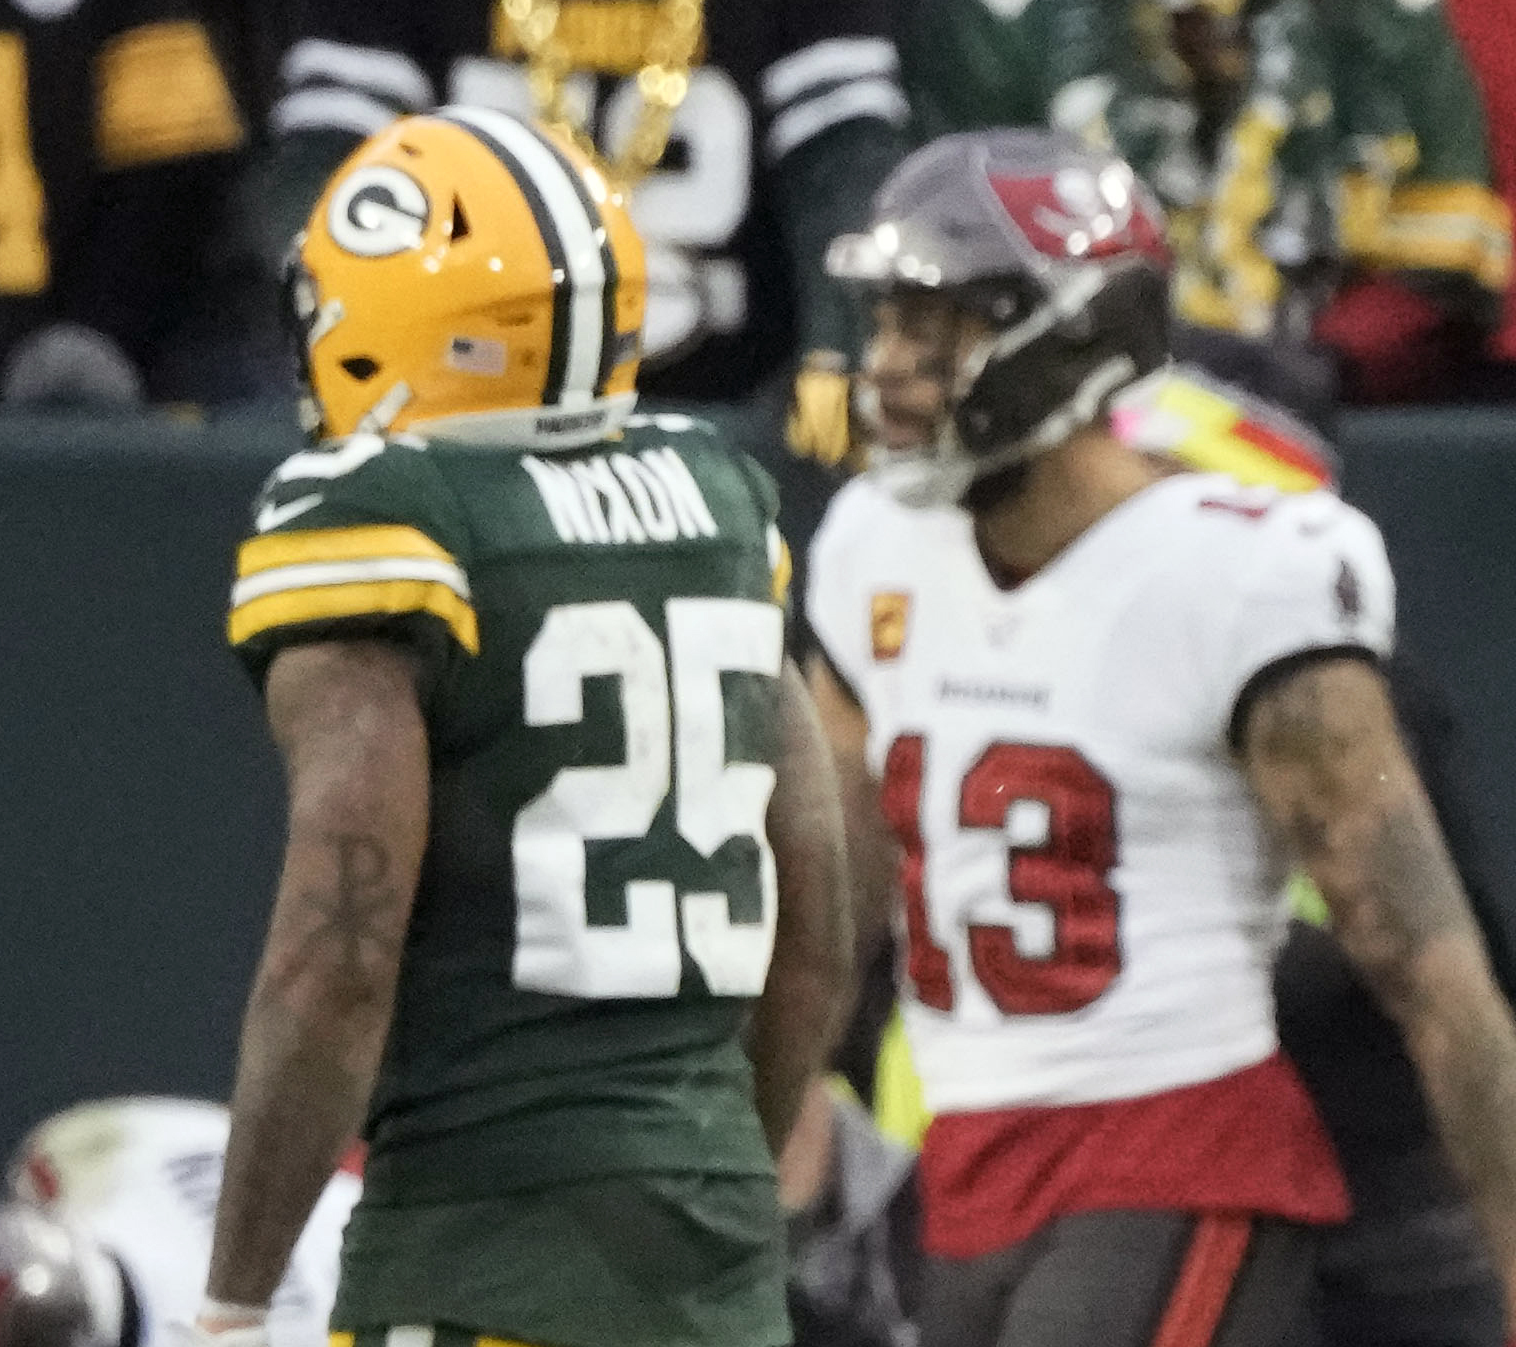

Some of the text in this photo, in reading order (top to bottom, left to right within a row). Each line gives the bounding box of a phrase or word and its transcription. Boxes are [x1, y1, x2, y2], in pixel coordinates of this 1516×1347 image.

[520, 446, 719, 544] NIXON
[511, 597, 785, 998] 25
[885, 732, 1123, 1016] 13
